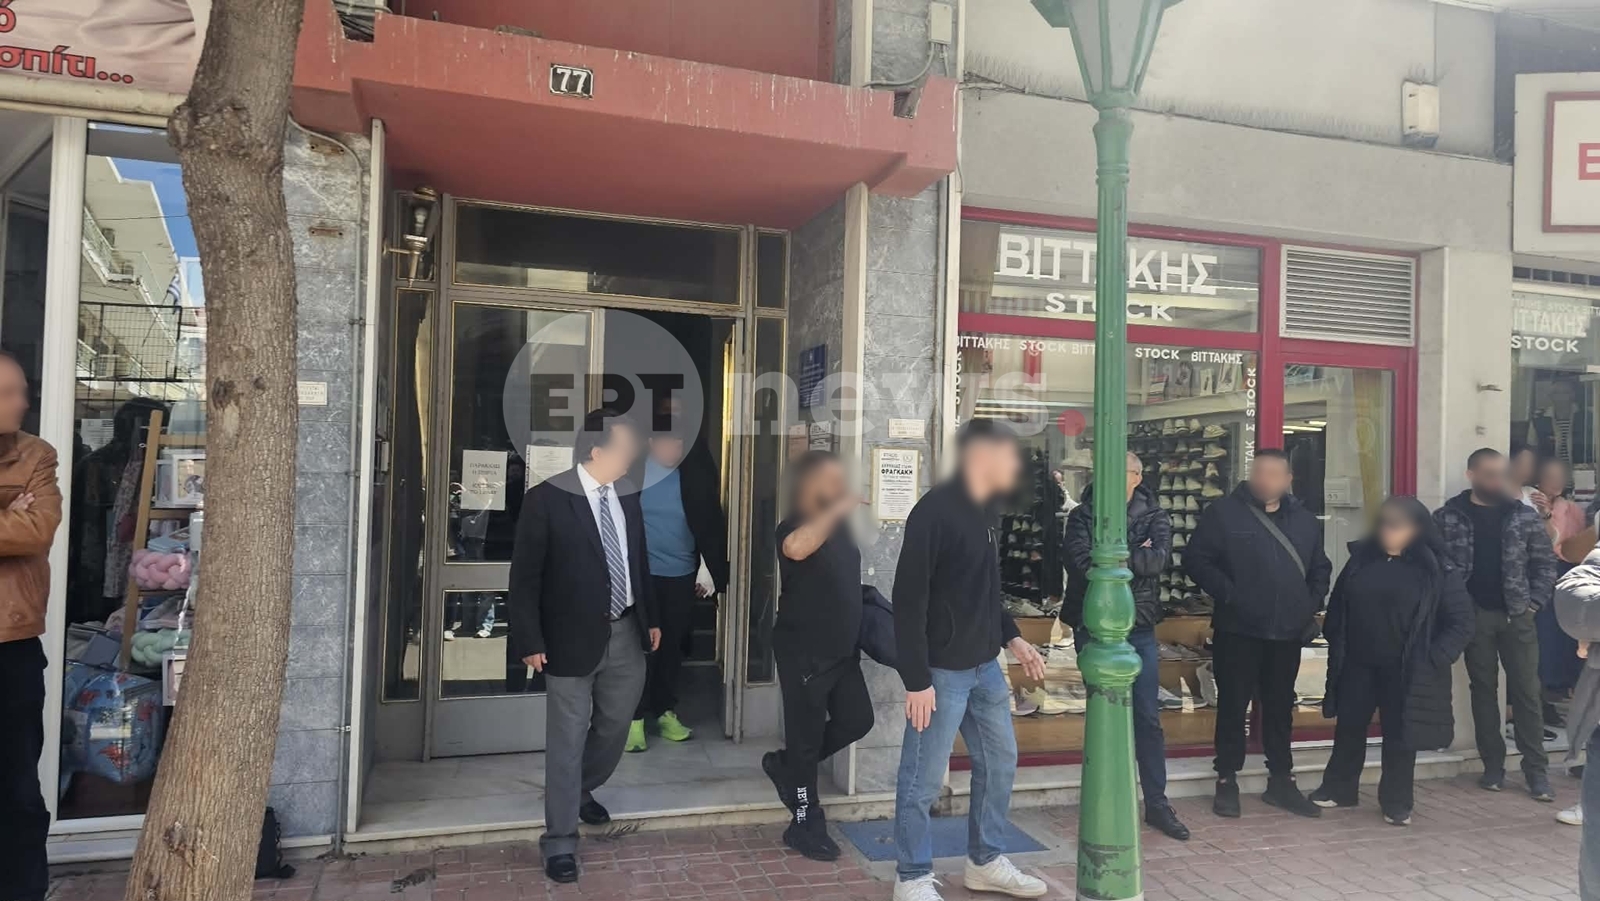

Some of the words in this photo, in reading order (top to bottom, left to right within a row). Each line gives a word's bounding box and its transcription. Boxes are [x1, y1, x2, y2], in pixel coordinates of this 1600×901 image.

[556, 68, 588, 94] 77
[998, 233, 1218, 296] ΒΙΤΤΚΗΣ
[1045, 292, 1173, 322] STCK
[1513, 308, 1587, 338] ΙΤΤΑΚΗΣ
[1019, 340, 1067, 353] STOCK
[1135, 347, 1180, 360] STOCK
[1191, 351, 1243, 365] ΒΙΤΤΑΚΗΣ
[1511, 335, 1579, 353] STOCK
[1246, 367, 1257, 417] STOCK
